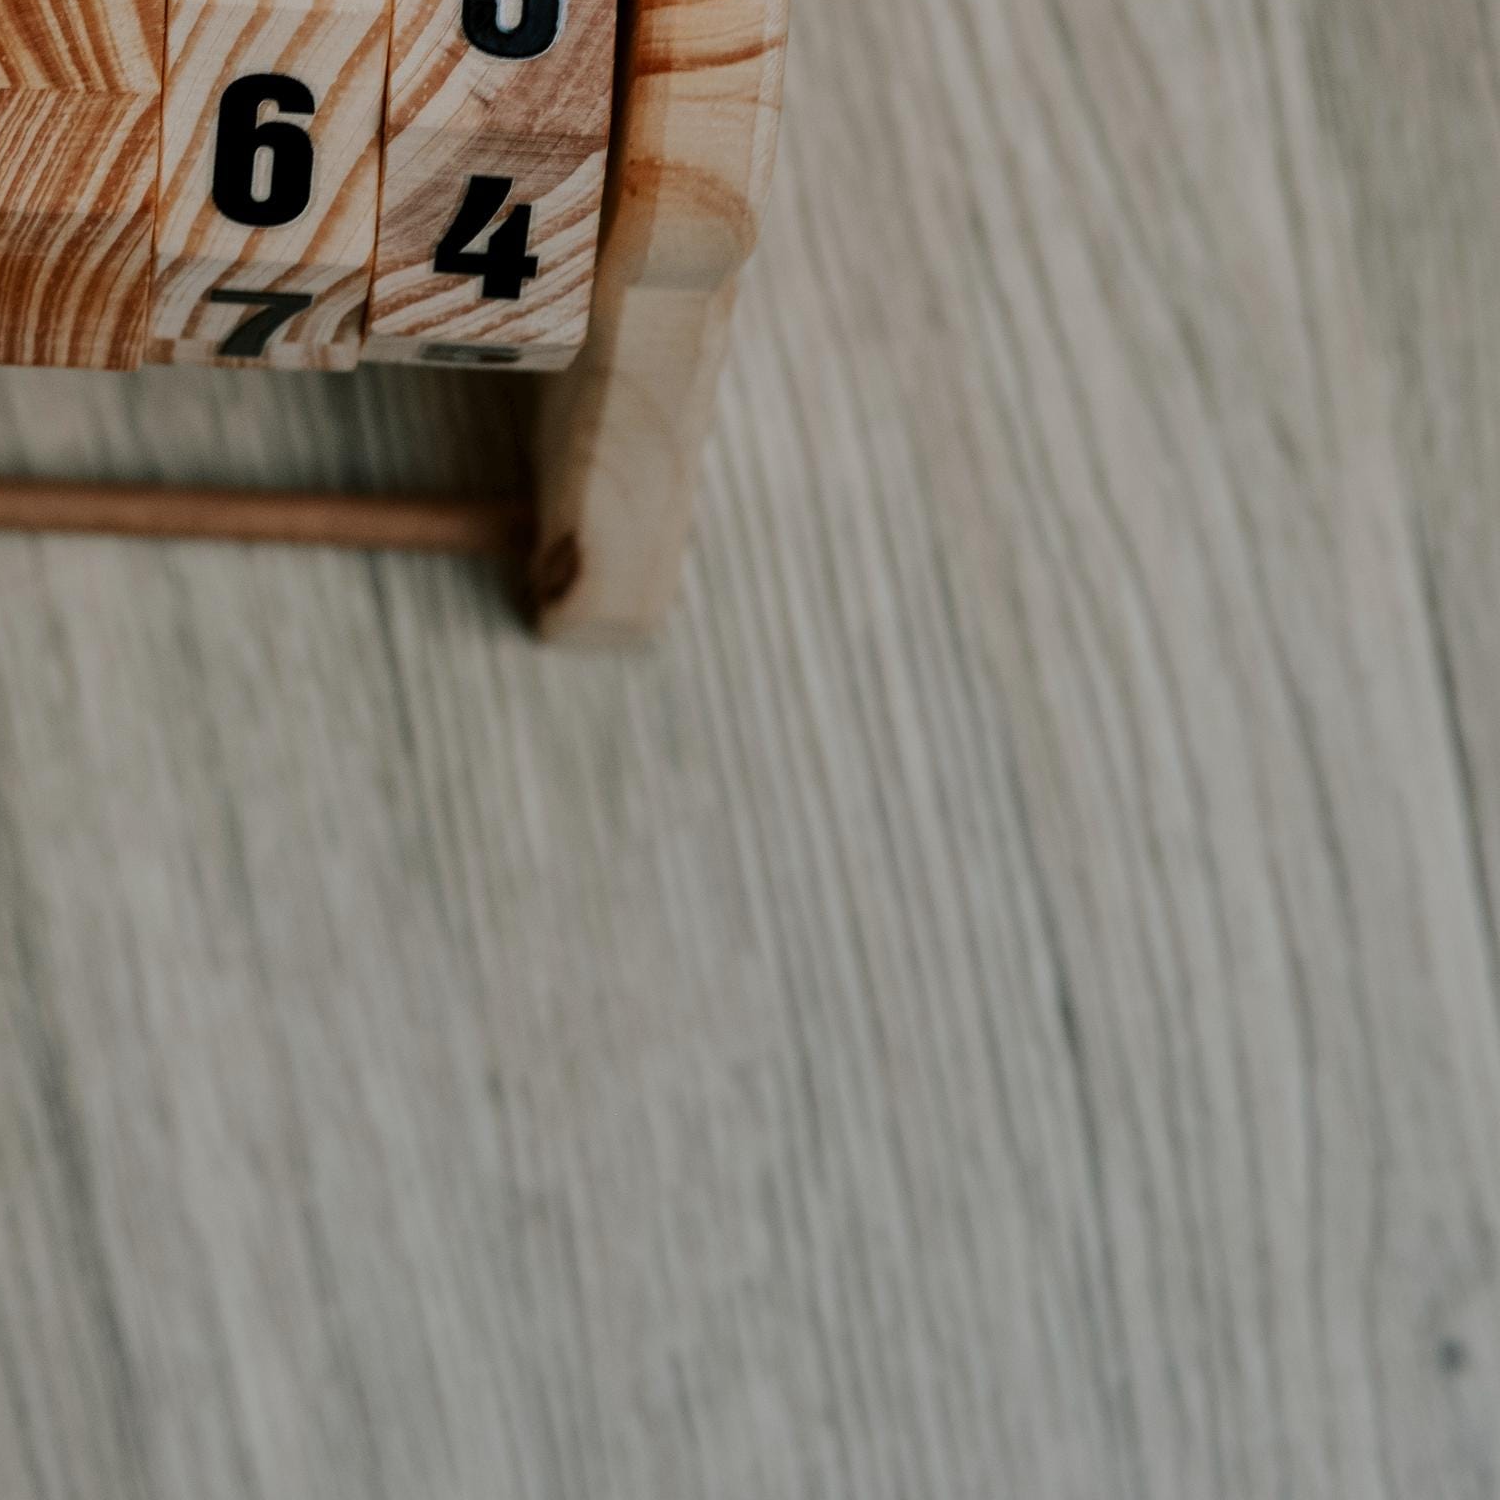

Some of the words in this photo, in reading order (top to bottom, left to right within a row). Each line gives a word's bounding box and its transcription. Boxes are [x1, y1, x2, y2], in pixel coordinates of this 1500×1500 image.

[211, 72, 315, 228] 6
[432, 175, 539, 300] 4
[209, 289, 313, 358] 7
